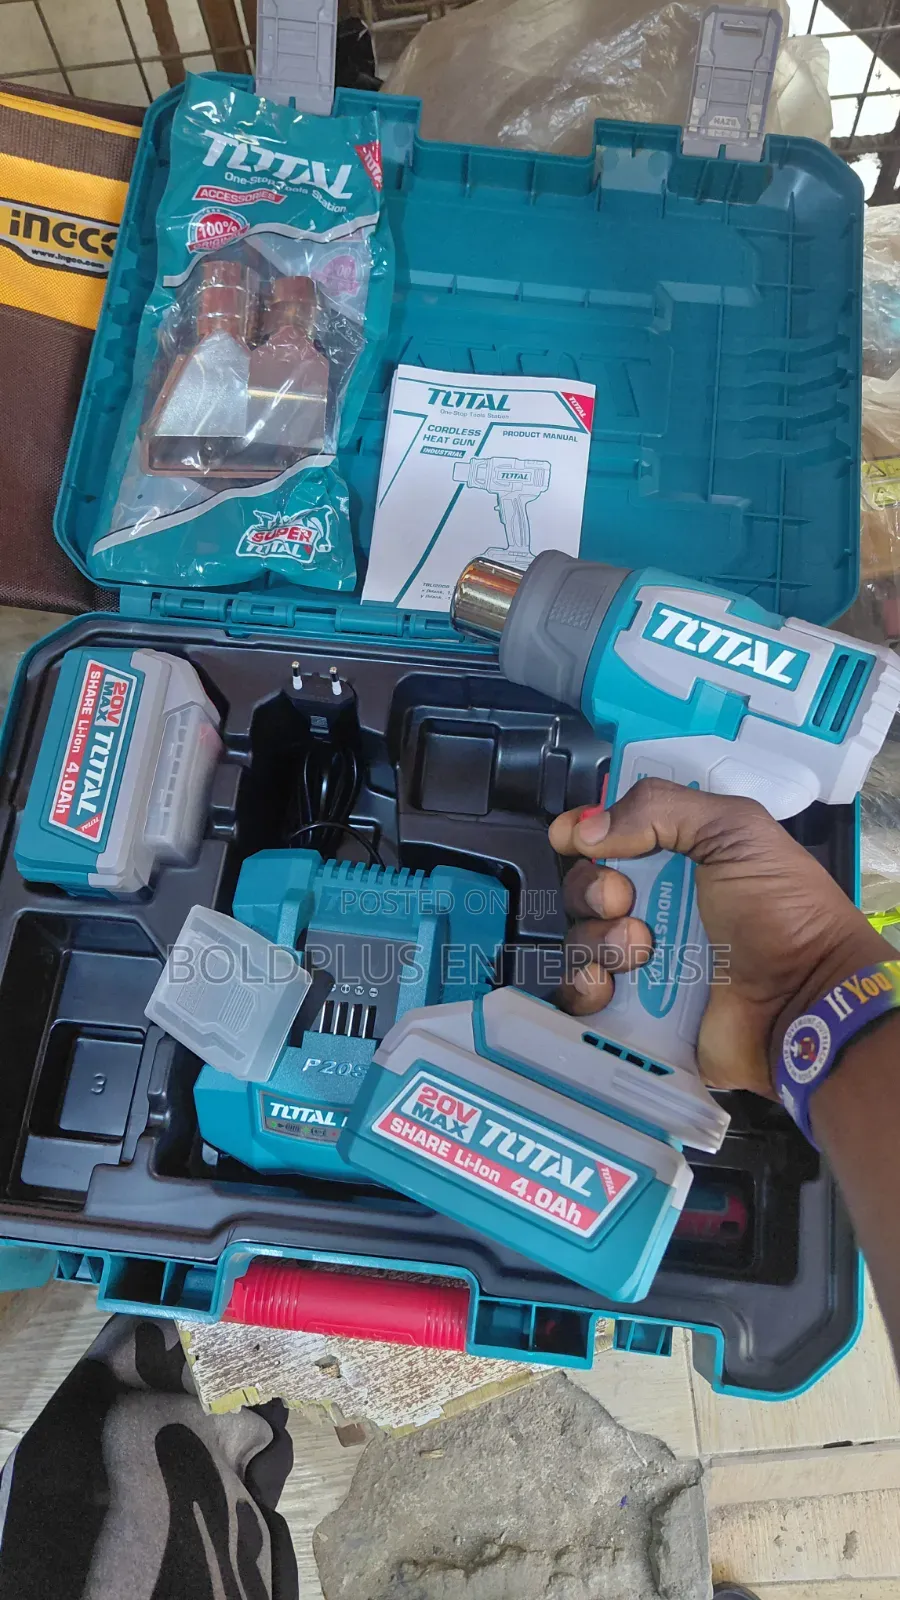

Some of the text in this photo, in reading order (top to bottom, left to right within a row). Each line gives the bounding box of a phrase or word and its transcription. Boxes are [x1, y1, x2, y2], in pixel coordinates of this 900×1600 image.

[202, 129, 353, 199] TOTAL
[199, 188, 275, 203] ACCESSORIES
[311, 189, 347, 213] Station
[198, 220, 238, 238] 100%
[31, 248, 105, 269] www.ingco.com
[427, 387, 511, 411] TOTAL
[567, 396, 586, 419] TOTAL
[422, 434, 476, 447] HEAT GUN
[427, 424, 482, 437] CORDLESS
[502, 430, 578, 443] PRODUCT MANUAL
[422, 447, 464, 457] INDUSTRIAL
[500, 472, 529, 481] TOTAL
[251, 526, 313, 543] SUPER
[246, 541, 302, 558] TOTAL
[652, 608, 797, 684] TOTAL
[79, 670, 101, 715] SHARE
[95, 680, 116, 722] MAX
[107, 681, 129, 727] 20V
[76, 730, 116, 816] TOTAL
[56, 762, 80, 814] 4.0Ah
[824, 985, 853, 1022] If
[842, 970, 893, 1005] You
[270, 1102, 336, 1127] TOTAL
[416, 1085, 478, 1123] 20V
[411, 1103, 471, 1140] MAX
[479, 1117, 598, 1197] TOTAL
[389, 1116, 449, 1157] SHARE
[510, 1176, 582, 1226] 4.0Ah
[600, 1166, 616, 1197] TOTAL
